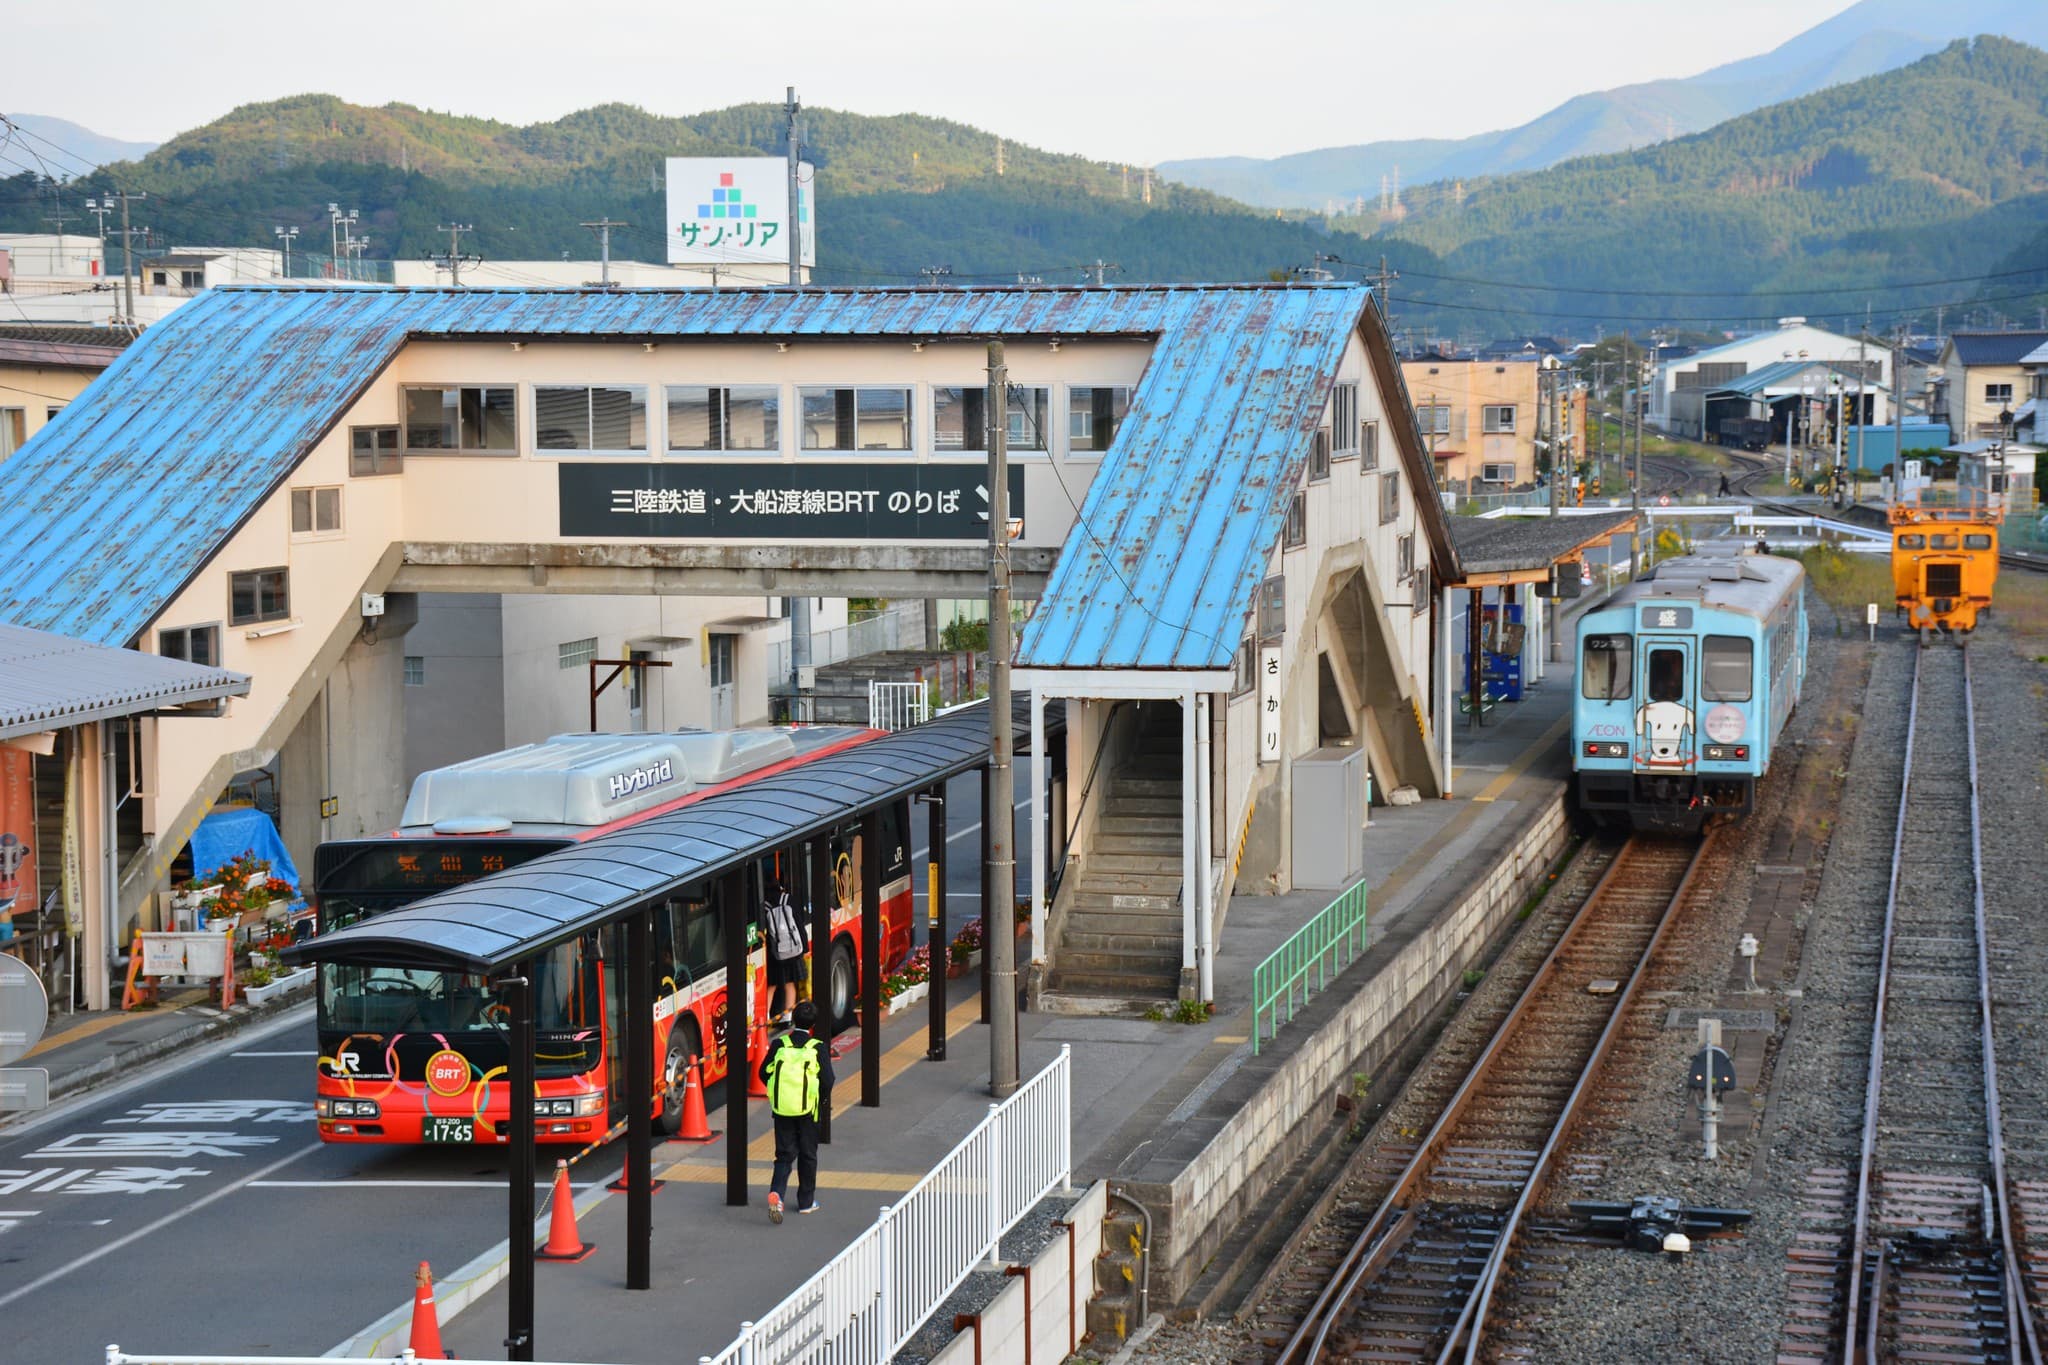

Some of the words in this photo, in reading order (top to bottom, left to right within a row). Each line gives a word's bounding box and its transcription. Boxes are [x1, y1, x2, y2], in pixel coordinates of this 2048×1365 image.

[677, 222, 778, 247] サン・リア
[610, 488, 880, 515] 三陸鉄道・大船渡線BRT
[887, 489, 961, 514] のりば
[1266, 657, 1279, 751] さかり
[609, 758, 673, 800] Hybrid
[894, 846, 903, 863] JR
[747, 926, 757, 943] JR
[330, 1052, 360, 1072] JR
[435, 1068, 462, 1081] BRT
[433, 1124, 473, 1141] 17-65
